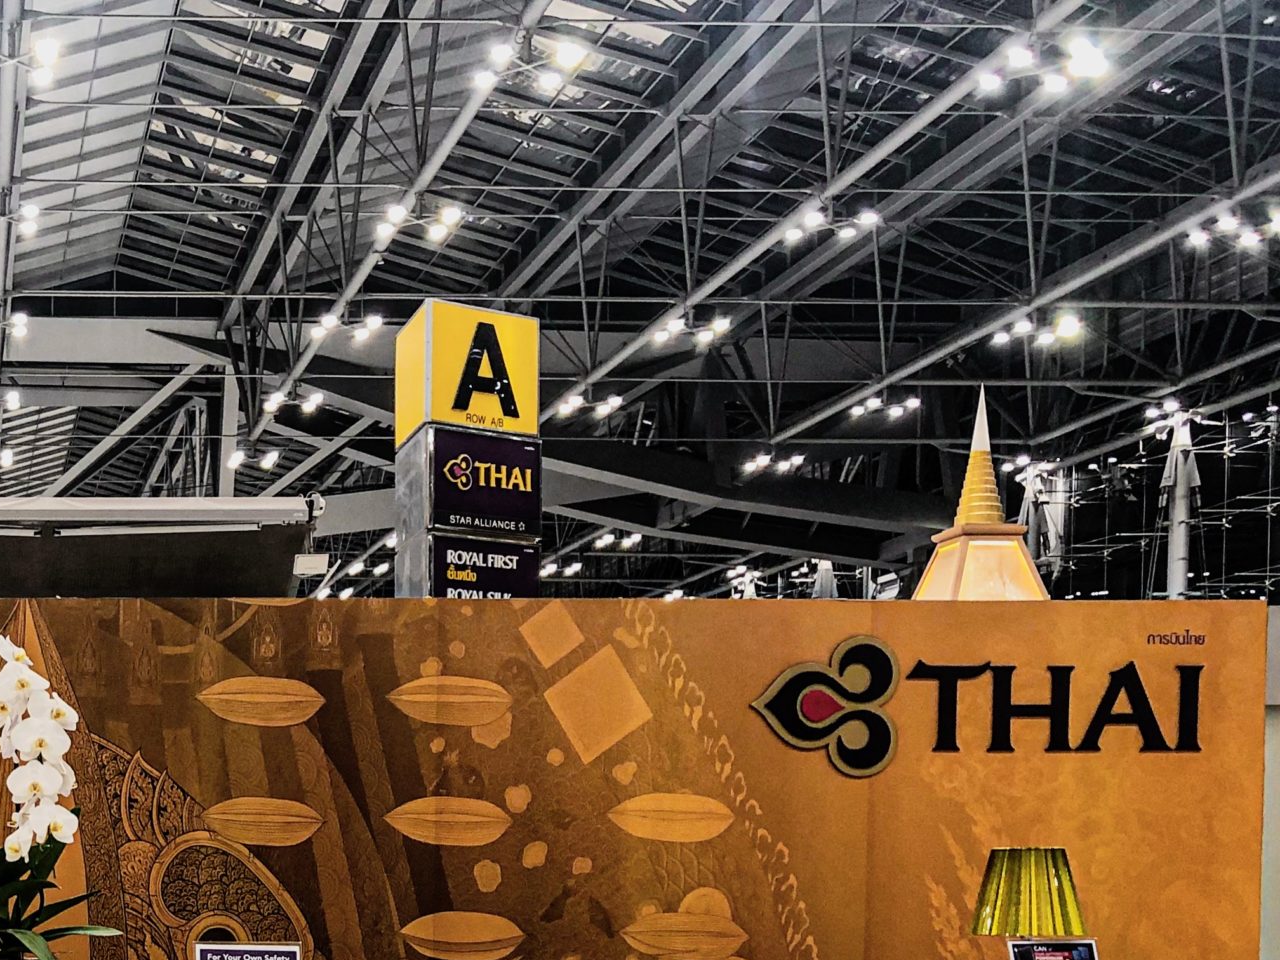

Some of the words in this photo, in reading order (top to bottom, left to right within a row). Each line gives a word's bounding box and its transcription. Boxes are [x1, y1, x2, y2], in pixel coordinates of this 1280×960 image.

[451, 321, 520, 419] A
[465, 413, 487, 425] ROW
[490, 417, 504, 428] A/B
[474, 460, 533, 492] THAI
[449, 514, 472, 526] STAR
[474, 517, 516, 531] ALLIANCE
[446, 549, 487, 567] ROYAL
[487, 553, 519, 570] FIRST
[446, 587, 483, 600] ROYAL
[1147, 629, 1207, 646] การบินไทย
[905, 658, 1205, 754] THAI
[207, 953, 221, 960] For
